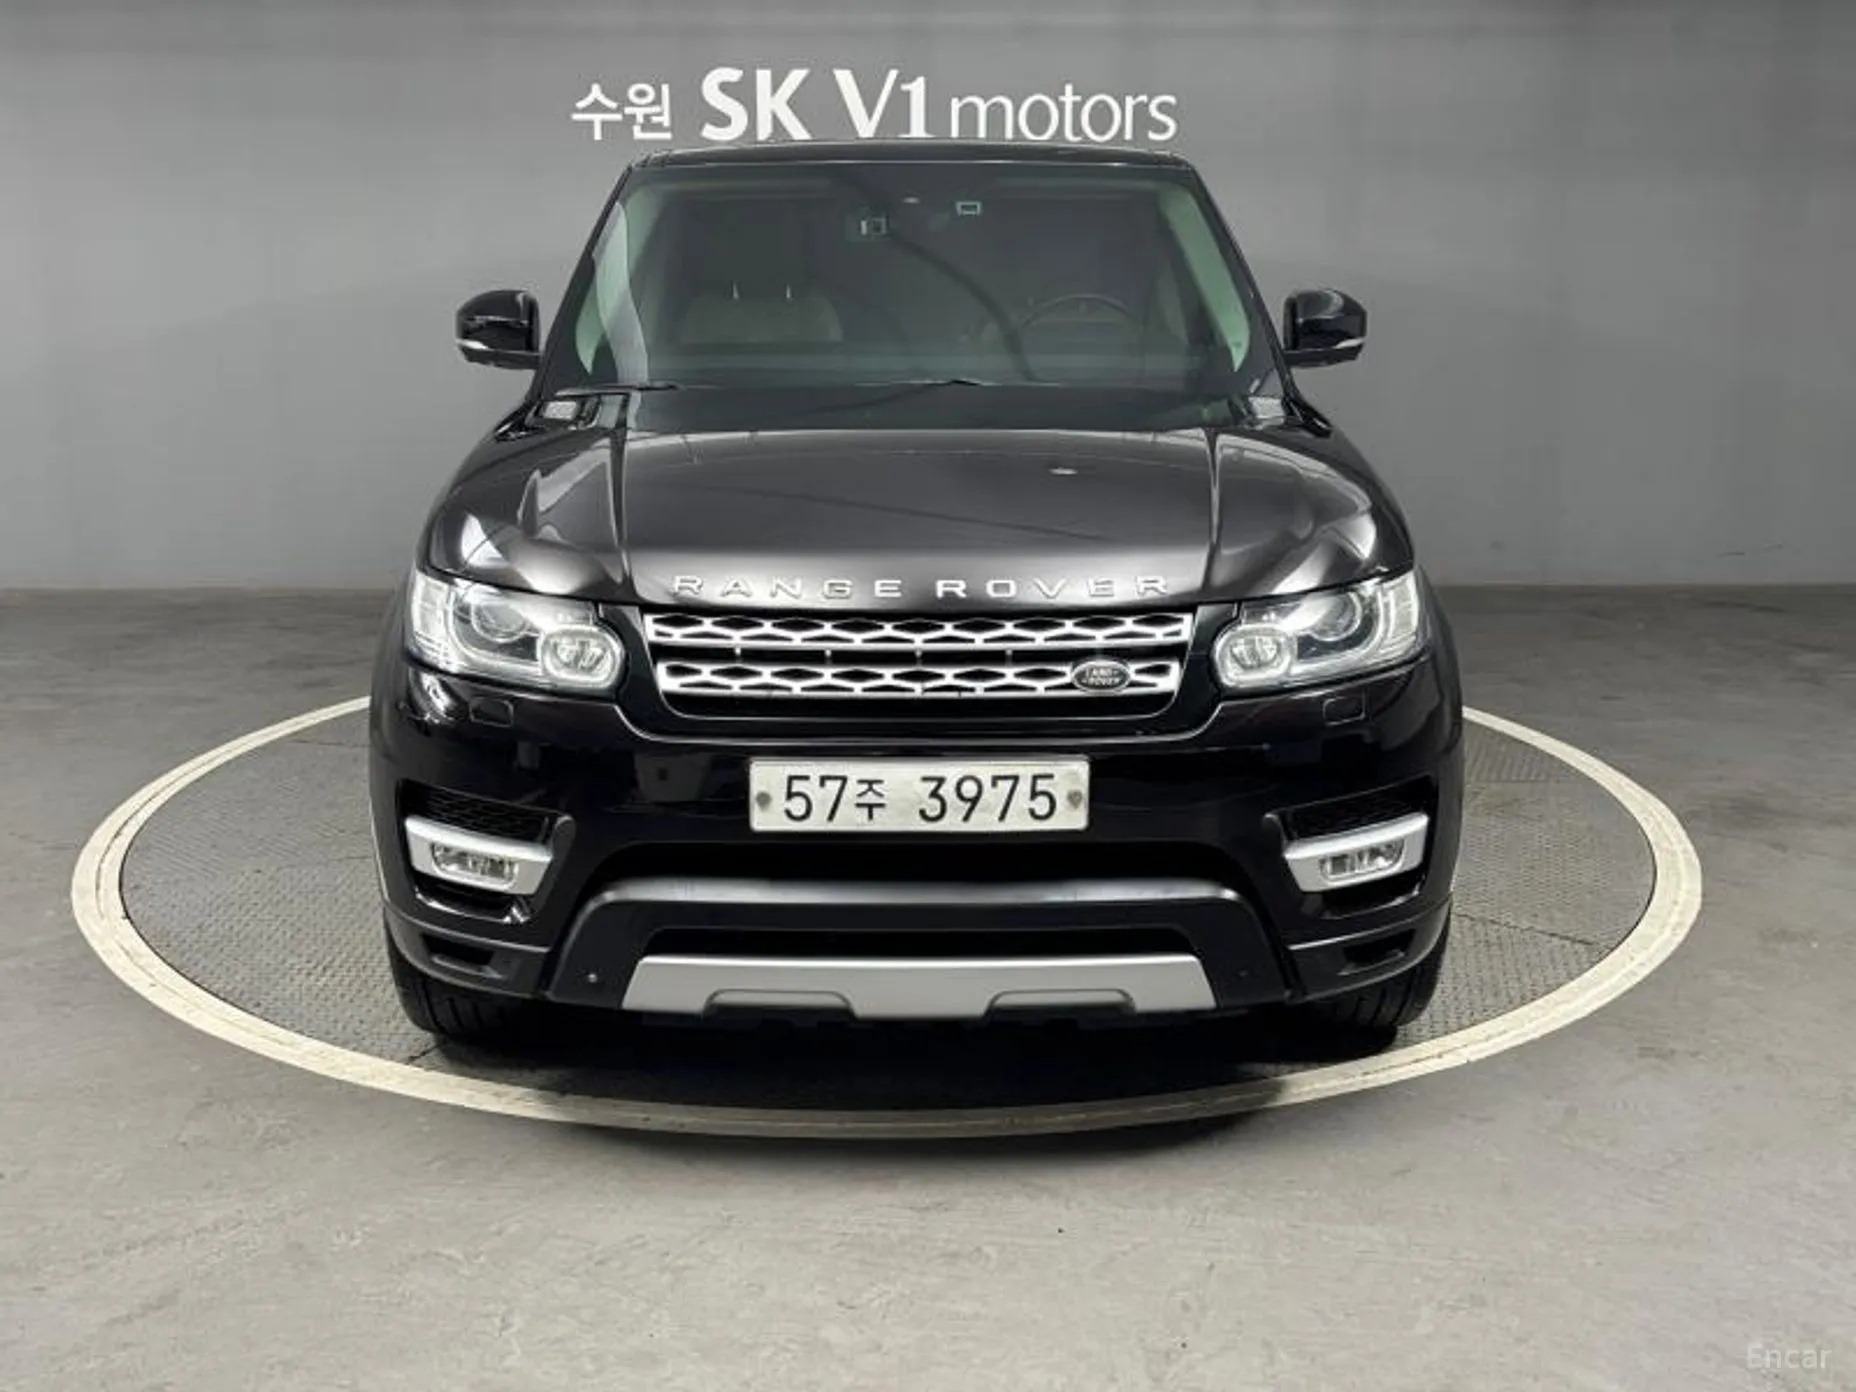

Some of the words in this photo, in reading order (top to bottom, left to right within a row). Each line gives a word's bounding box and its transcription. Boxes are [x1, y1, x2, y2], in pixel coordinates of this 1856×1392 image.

[571, 82, 672, 140] 수원
[701, 67, 812, 141] SK
[673, 575, 903, 599] RANGE
[936, 575, 1170, 598] ROVER
[783, 774, 887, 822] 57주
[918, 773, 1057, 822] 3975
